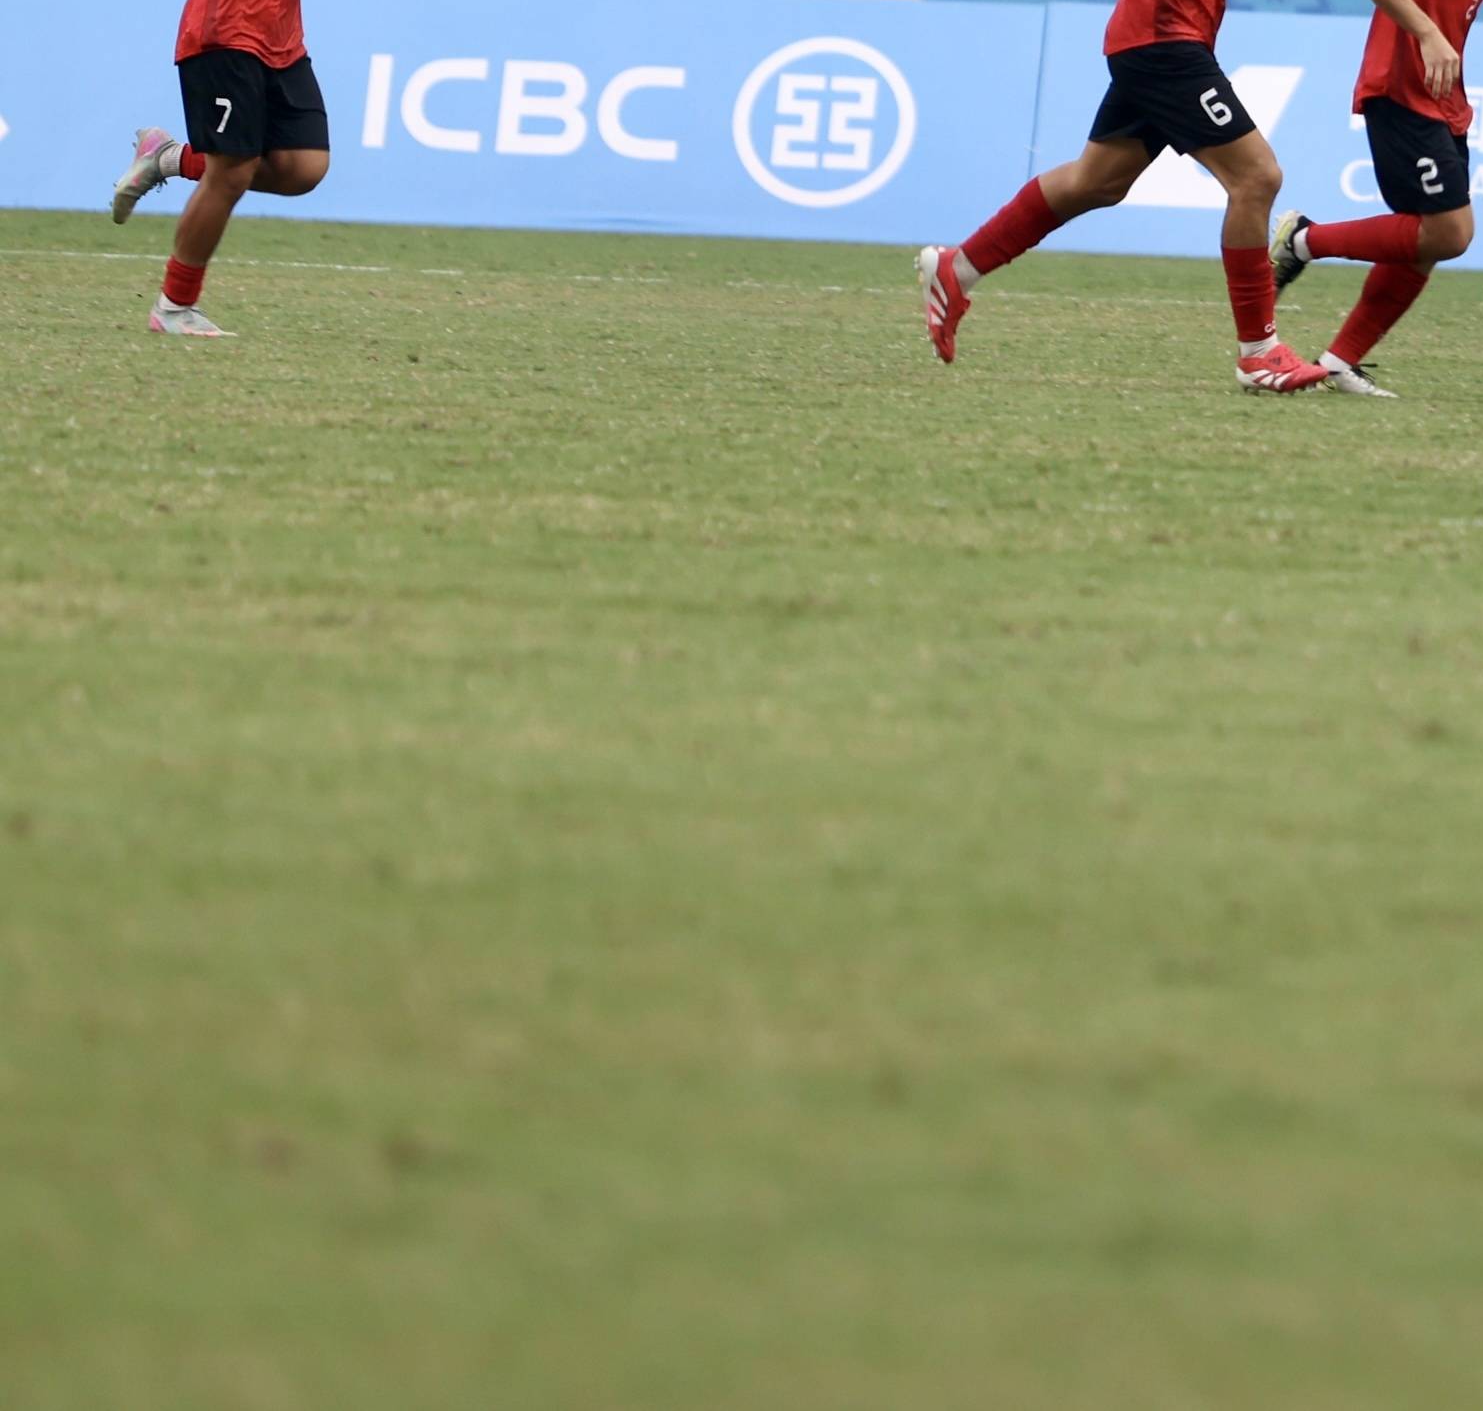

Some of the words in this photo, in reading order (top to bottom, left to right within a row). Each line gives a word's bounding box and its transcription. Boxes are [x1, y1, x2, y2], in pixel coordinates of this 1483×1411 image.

[215, 97, 232, 133] 7
[362, 54, 685, 161] ICBC
[1200, 87, 1232, 127] 6
[1416, 157, 1444, 195] 2
